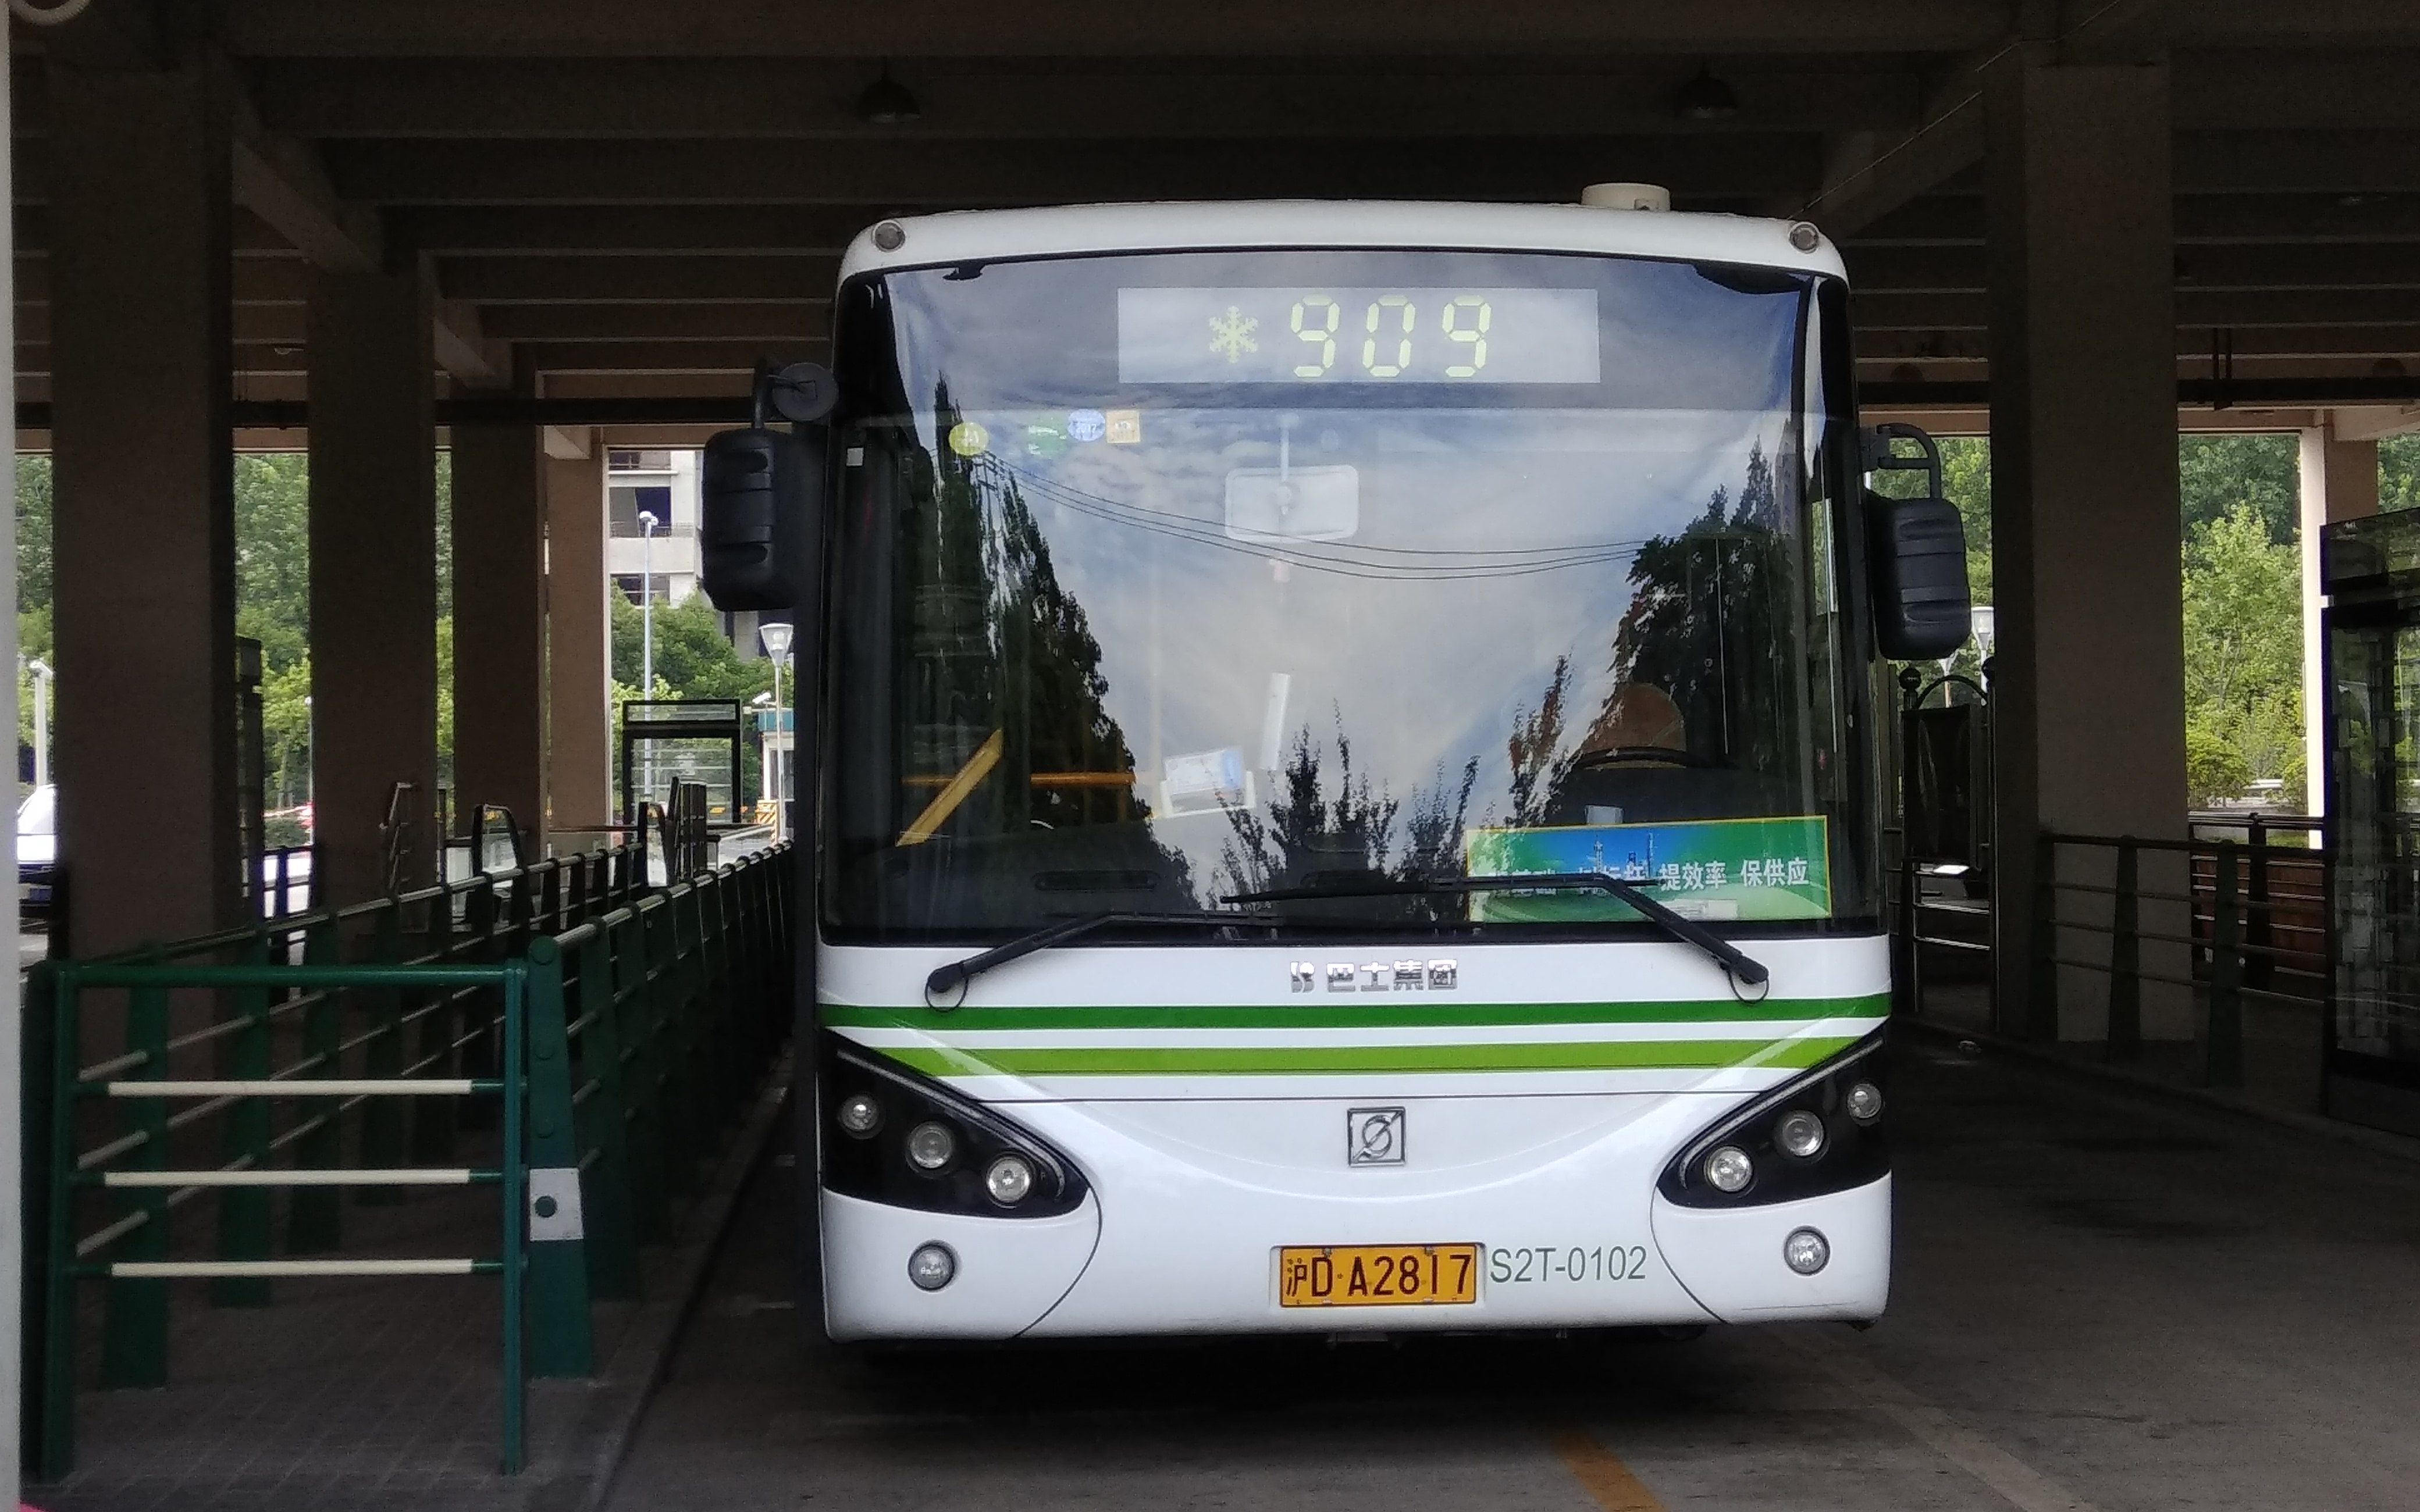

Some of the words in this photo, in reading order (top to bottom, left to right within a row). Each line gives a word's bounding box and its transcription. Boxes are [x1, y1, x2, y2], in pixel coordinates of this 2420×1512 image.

[1290, 294, 1492, 378] 909
[1659, 860, 1727, 891] 提效率
[1741, 857, 1810, 888] 保供应
[1326, 959, 1458, 992] 巴士集团
[1489, 1245, 1648, 1283] S2T-0102
